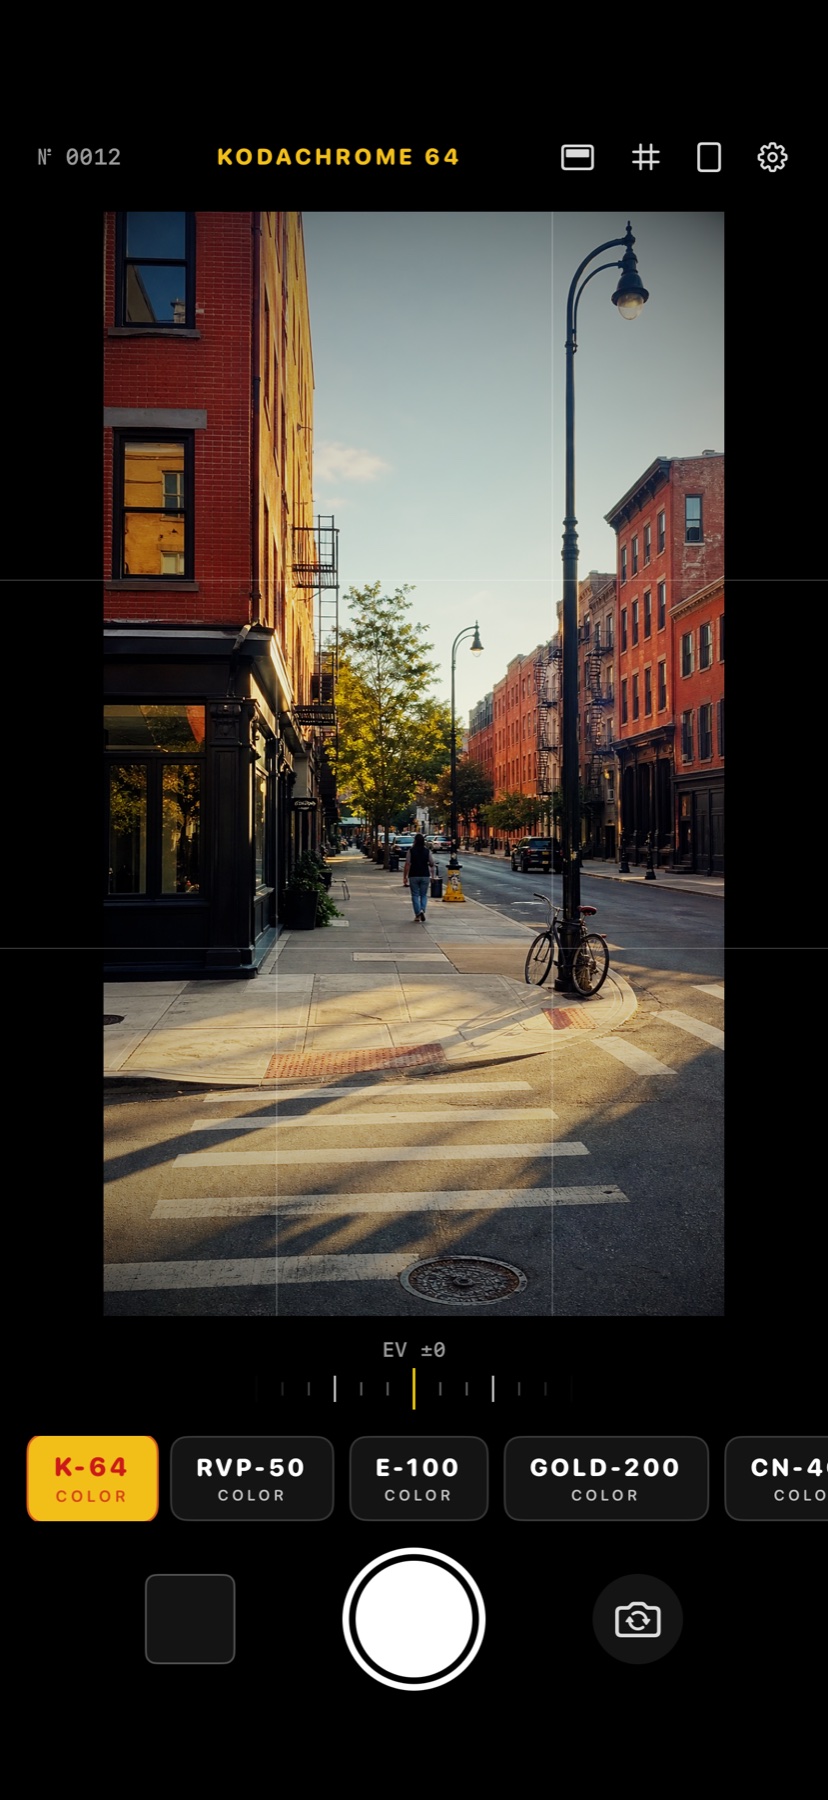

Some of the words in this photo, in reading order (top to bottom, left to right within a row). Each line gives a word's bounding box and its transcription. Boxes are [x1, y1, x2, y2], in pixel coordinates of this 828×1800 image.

[66, 147, 121, 166] 0012
[217, 147, 413, 166] KODACHROME
[424, 147, 460, 166] 64
[383, 1341, 408, 1358] EV
[420, 1341, 446, 1358] ±0
[54, 1456, 128, 1477] K-64
[196, 1457, 305, 1478] RVP-50
[376, 1457, 459, 1478] E-100
[529, 1457, 679, 1478] GOLD-200
[750, 1457, 828, 1478] CN-4
[55, 1489, 126, 1503] COLOR
[217, 1489, 284, 1502] COLOR
[384, 1489, 451, 1502] COLOR
[571, 1489, 637, 1502] COLOR
[773, 1489, 827, 1502] COLO
